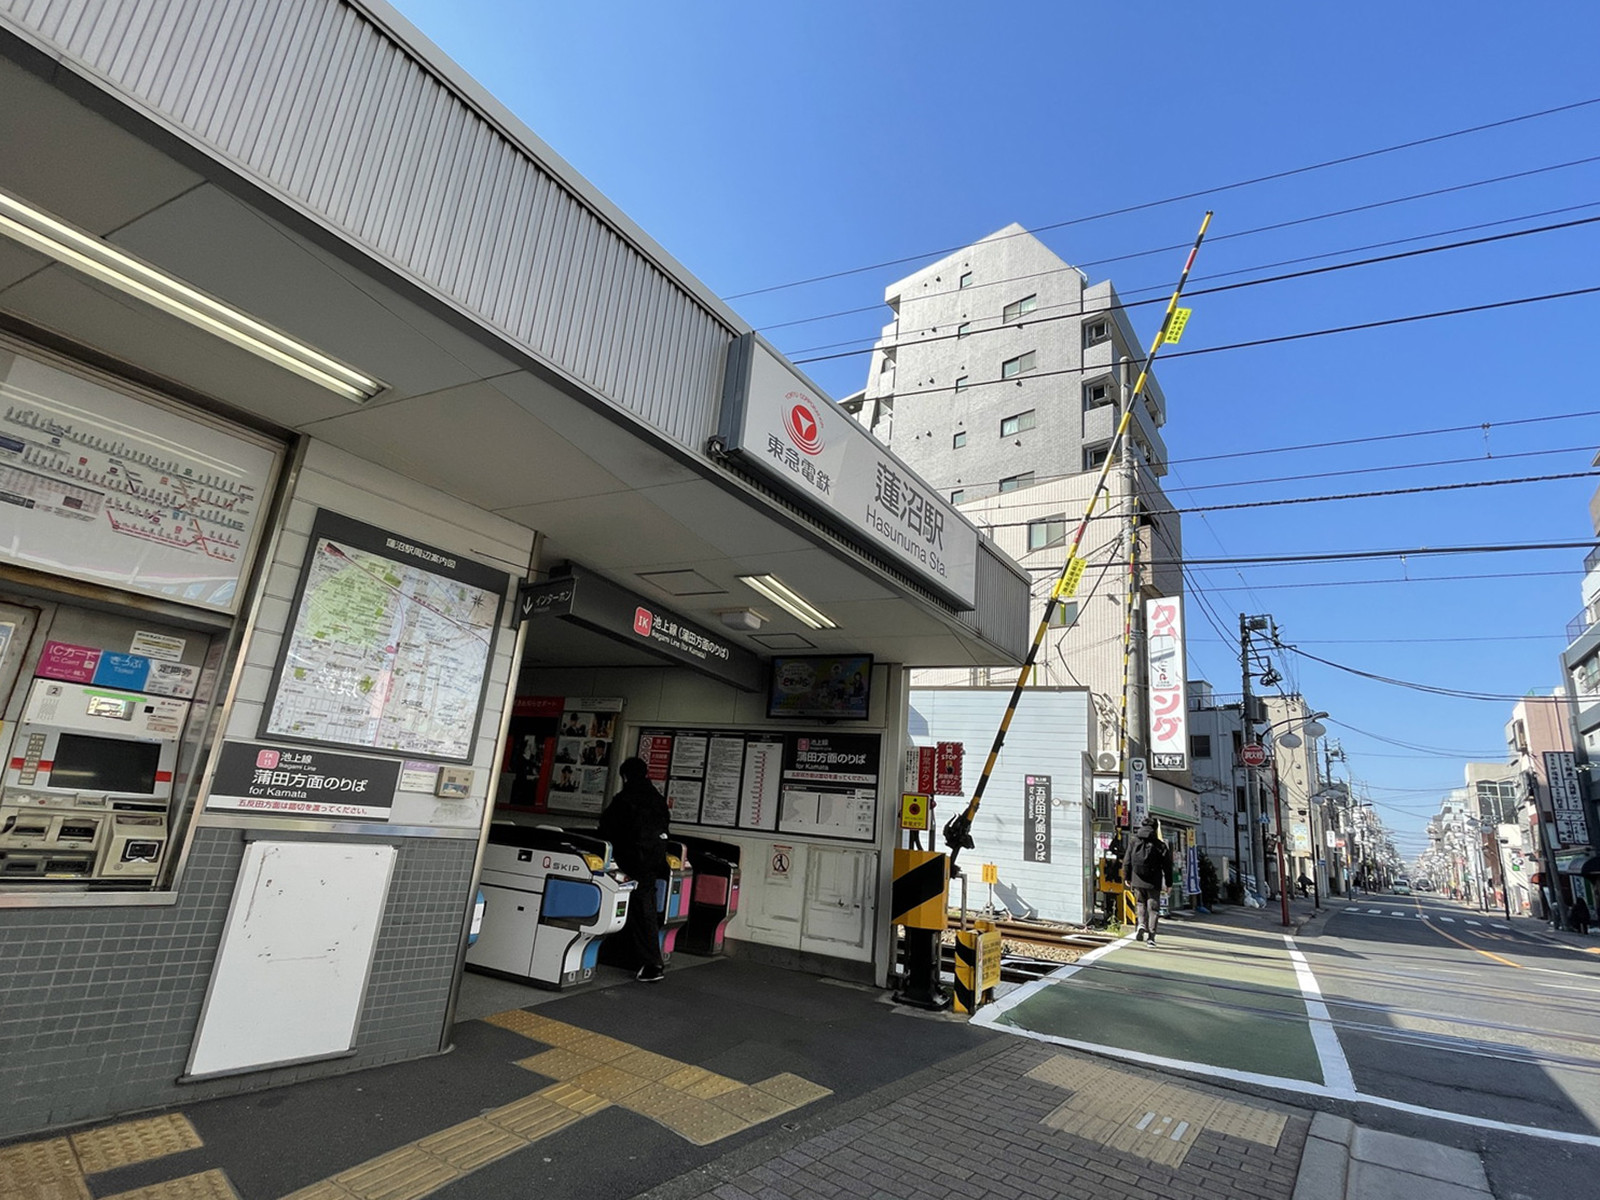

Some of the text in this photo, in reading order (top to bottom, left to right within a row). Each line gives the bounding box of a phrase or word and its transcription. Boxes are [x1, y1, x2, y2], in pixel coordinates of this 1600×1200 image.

[767, 433, 831, 496] 東急電鉄
[875, 461, 944, 551] 蓮沼駅
[866, 505, 948, 578] Hasunuma Sta.
[638, 616, 649, 629] IK
[49, 645, 100, 661] ICカード
[109, 655, 143, 668] きっぷ
[1151, 604, 1182, 741] クング
[280, 751, 313, 764] 池上線
[796, 752, 867, 765] 蒲田方面のりば
[278, 762, 317, 772] Ikegami Line
[252, 769, 369, 793] 蒲田方面のりば
[249, 786, 307, 799] for Kamata
[238, 799, 368, 815] 五反田方面は踏切を渡ってください。
[1035, 786, 1046, 861] 五反田方面のりば
[553, 862, 580, 873] SKIP
